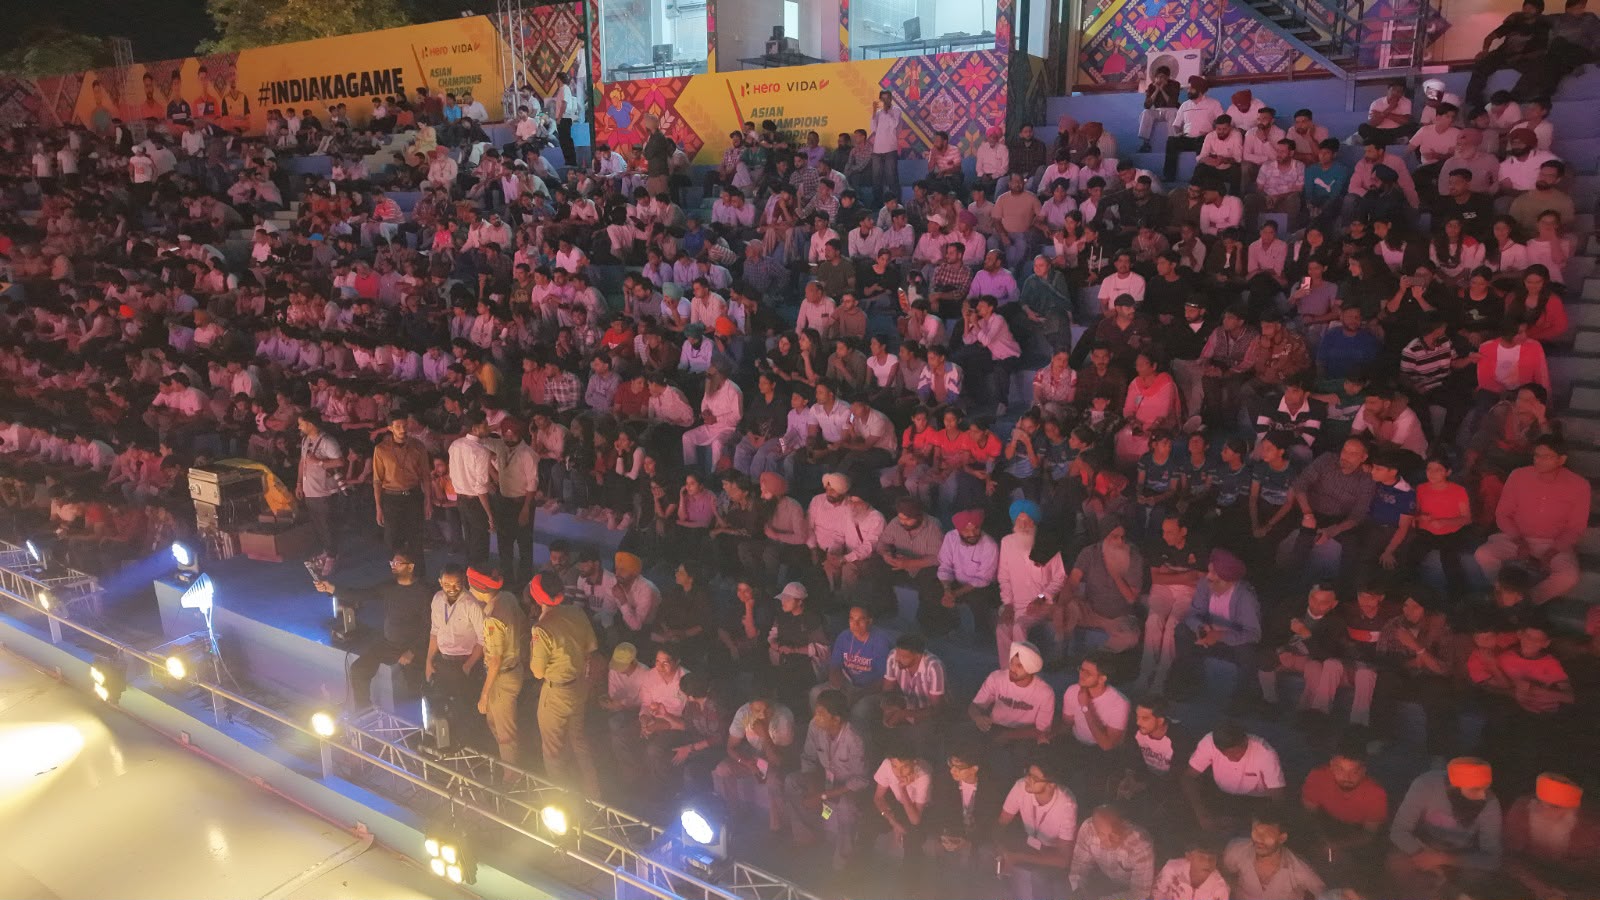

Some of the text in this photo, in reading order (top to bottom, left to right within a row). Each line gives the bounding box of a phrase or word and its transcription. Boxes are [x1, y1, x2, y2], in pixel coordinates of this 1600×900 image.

[451, 43, 473, 54] VIDA
[430, 67, 452, 77] ASIAN
[438, 74, 482, 87] CHAMPIONS
[786, 81, 818, 92] VIDA
[258, 68, 403, 107] #INDIAKAGAME
[750, 106, 784, 118] ASIAN
[763, 116, 828, 129] AMPIONS
